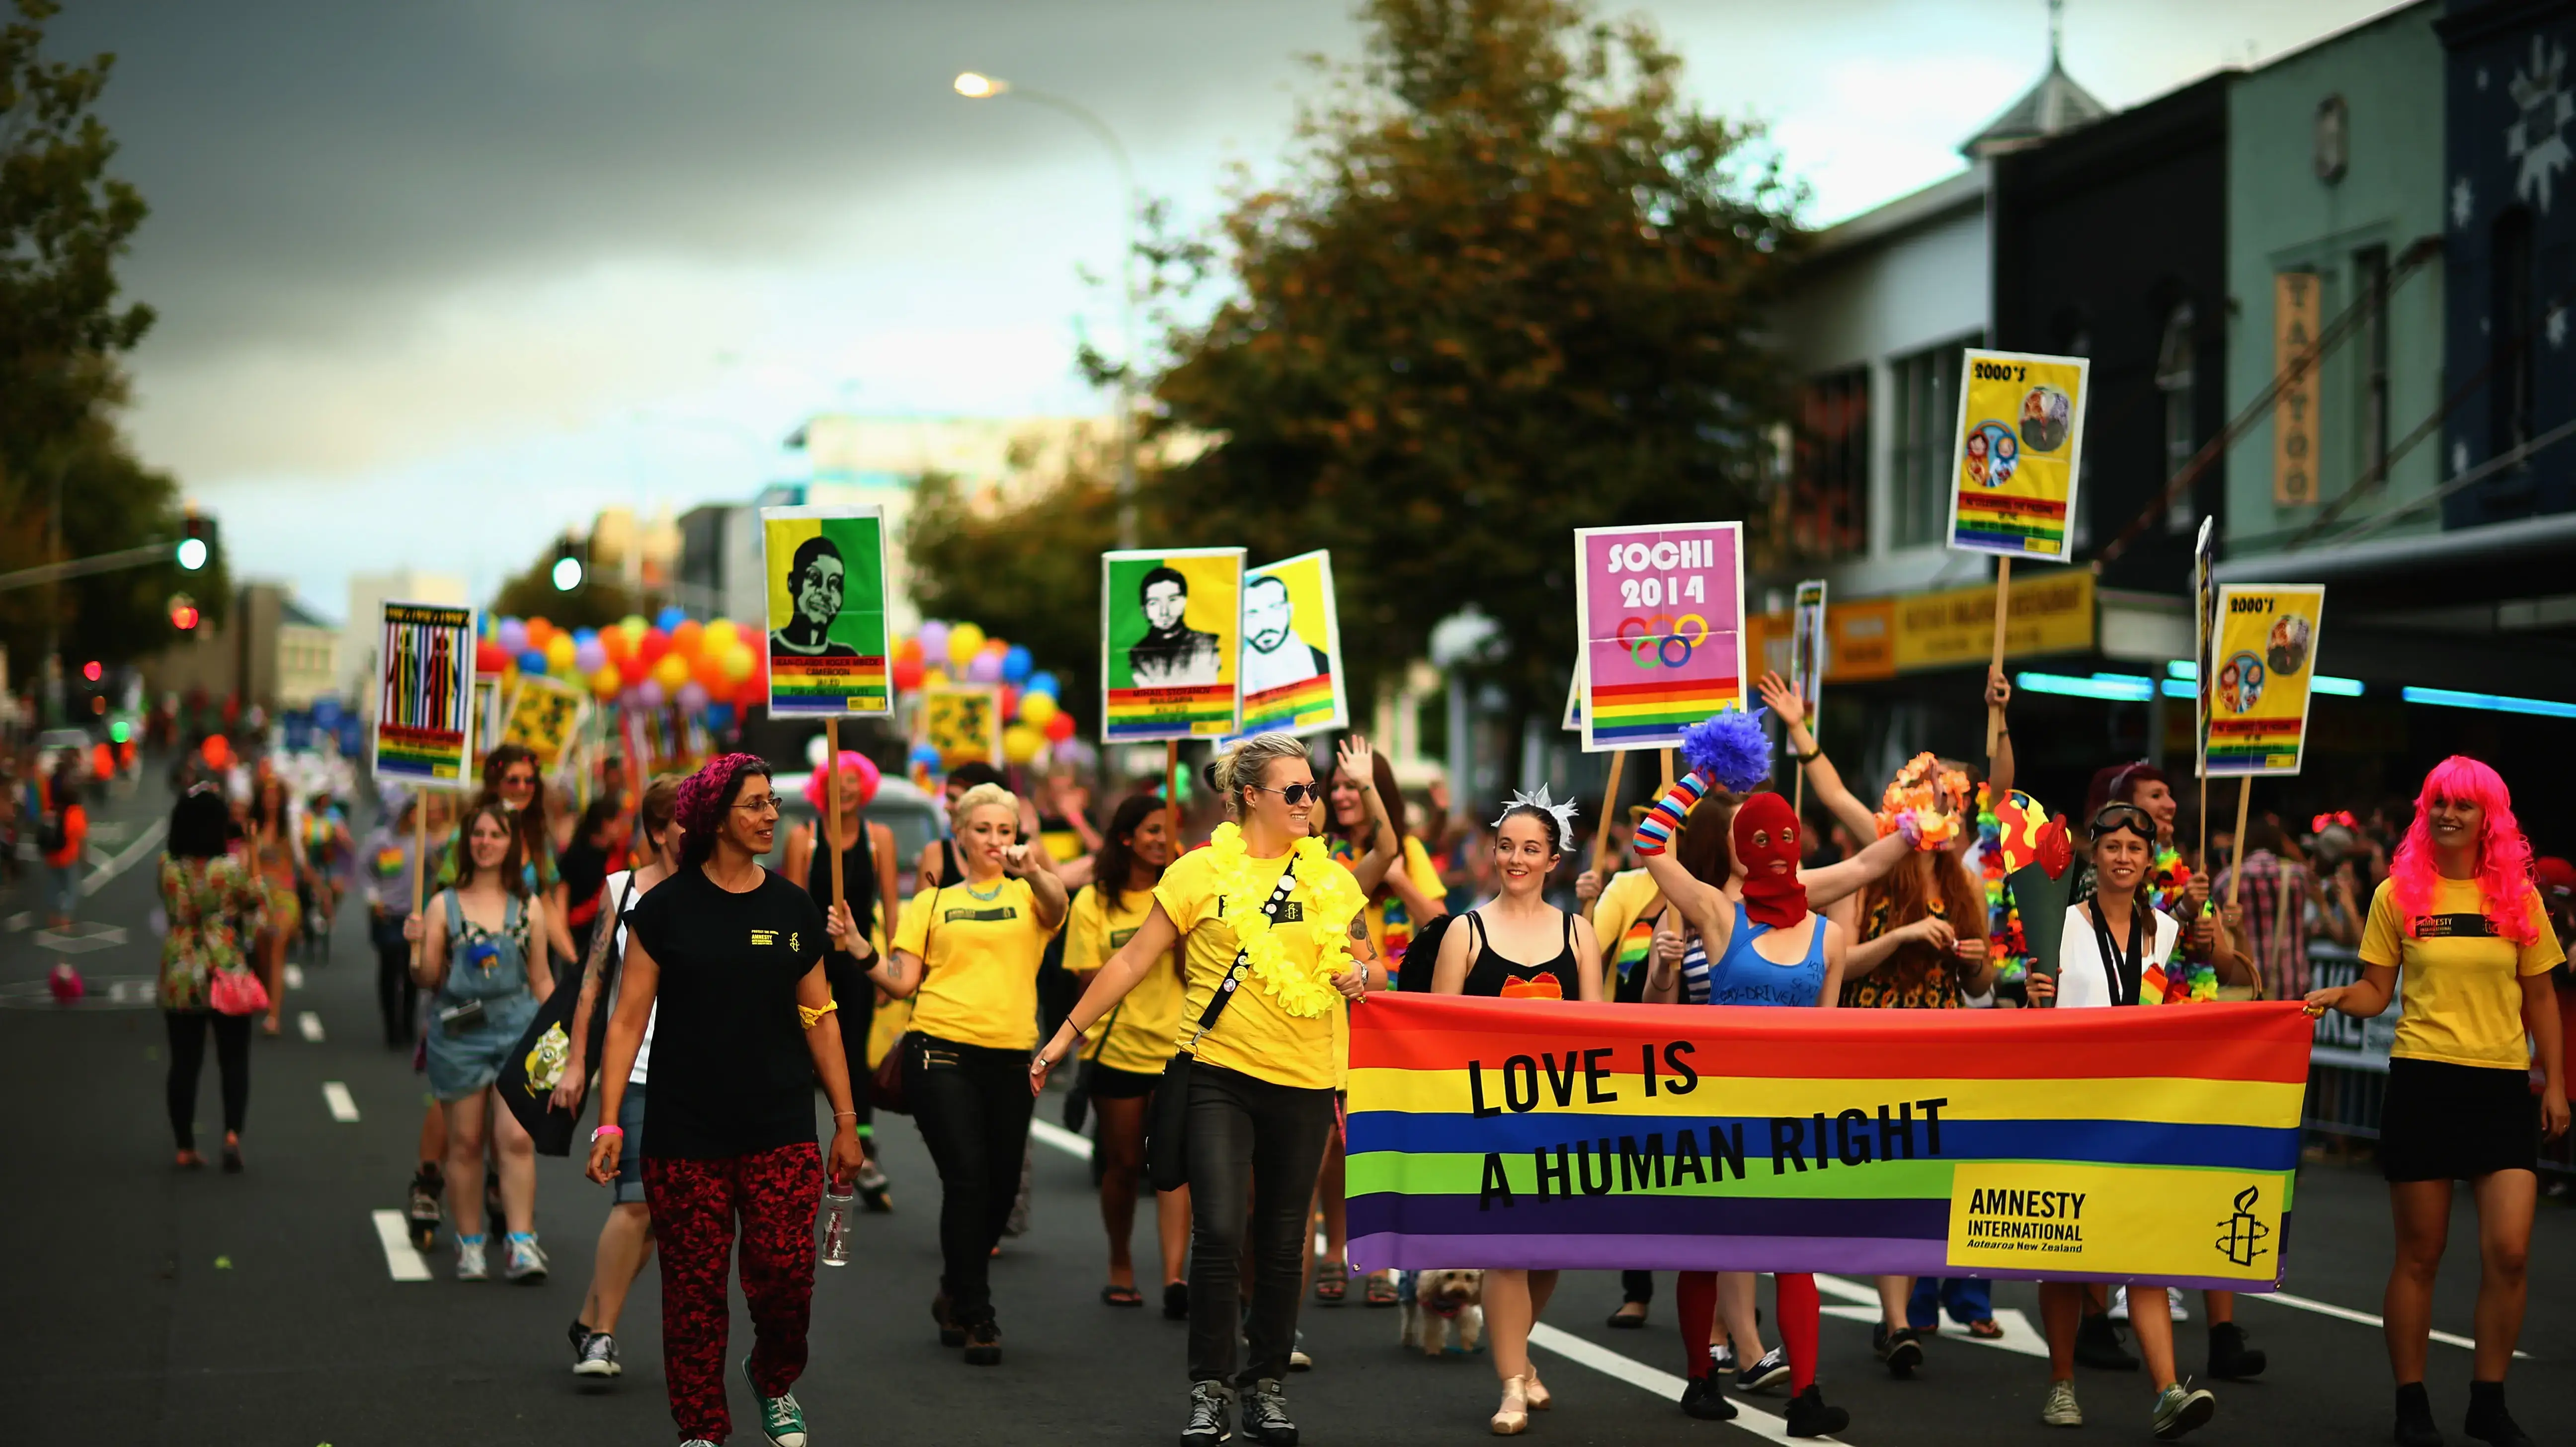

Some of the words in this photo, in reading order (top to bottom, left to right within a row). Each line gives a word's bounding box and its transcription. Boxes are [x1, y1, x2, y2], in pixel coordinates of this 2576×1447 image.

[1608, 539, 1713, 573] SOCHI
[1620, 575, 1704, 608] 2014
[1468, 1048, 1617, 1119] LOVE
[1642, 1041, 1698, 1097] IS
[1479, 1152, 1515, 1211] A
[1534, 1123, 1746, 1203] HUMAN
[1770, 1097, 1948, 1176] RIGHT
[1968, 1188, 2087, 1219] AMNESTY
[1966, 1239, 2014, 1249] Aotearoa
[2016, 1242, 2038, 1250] New
[2041, 1243, 2083, 1253] Zealand
[1967, 1219, 2083, 1241] INTERNATIONAL
